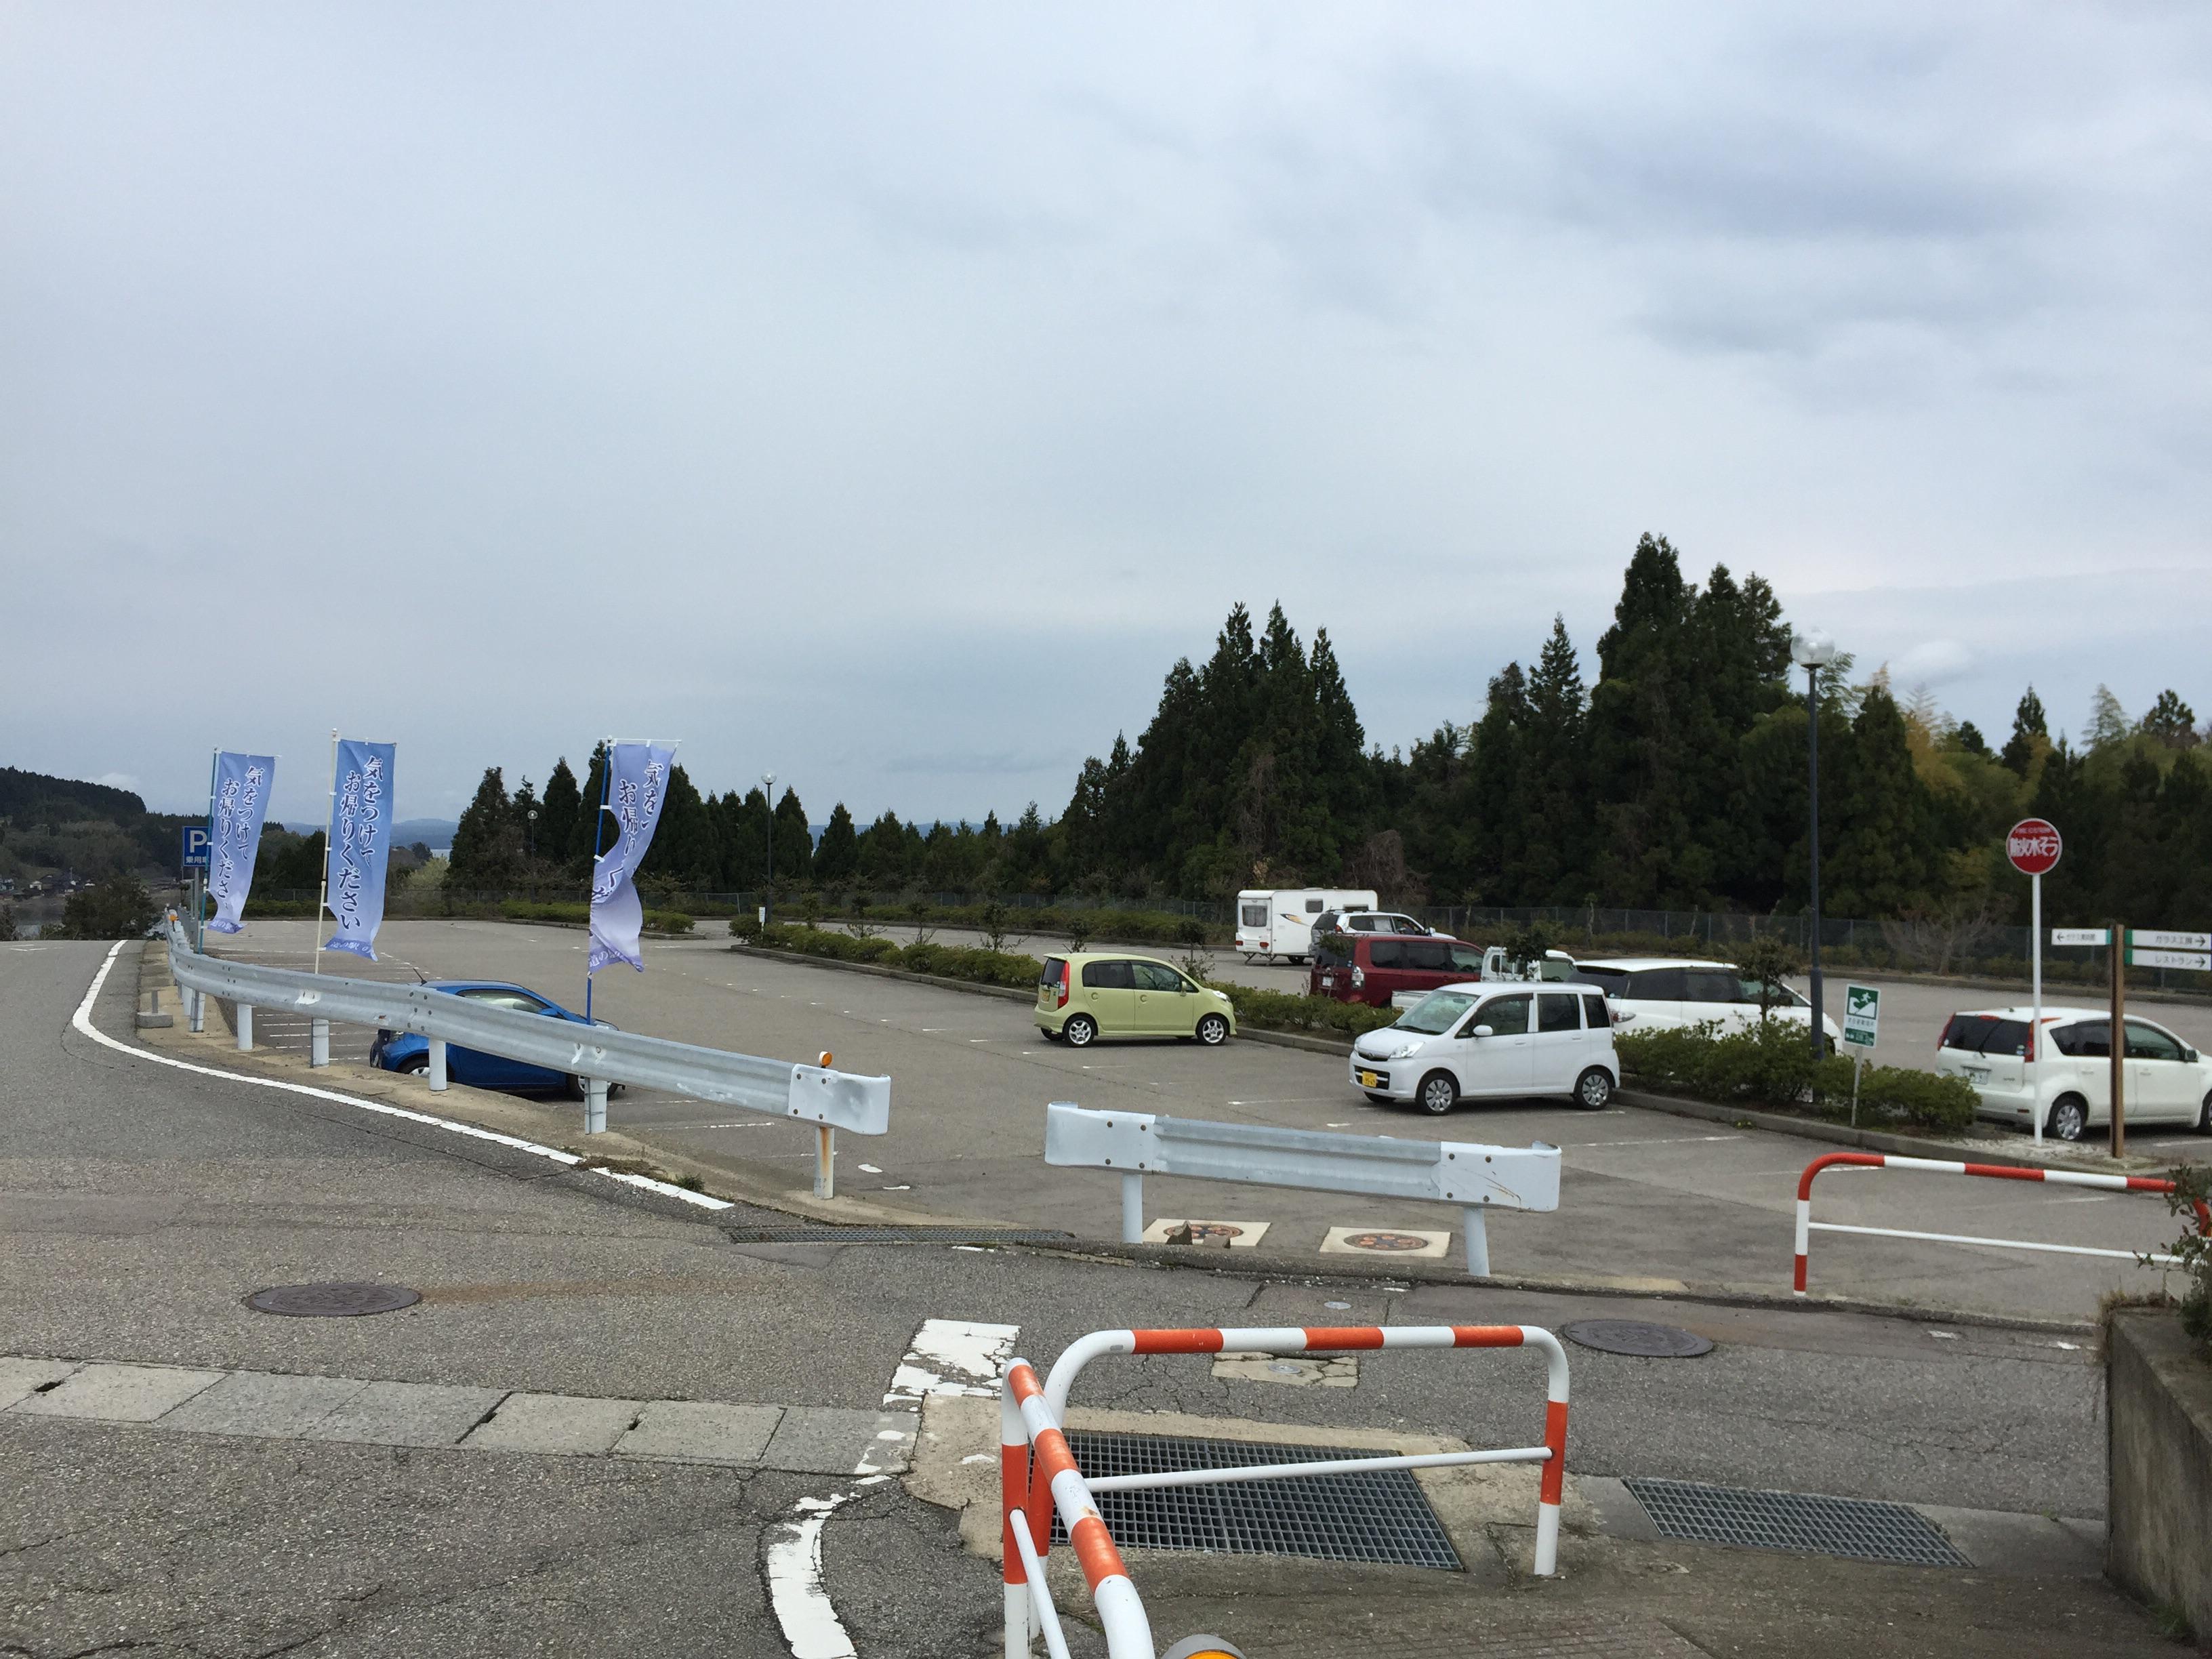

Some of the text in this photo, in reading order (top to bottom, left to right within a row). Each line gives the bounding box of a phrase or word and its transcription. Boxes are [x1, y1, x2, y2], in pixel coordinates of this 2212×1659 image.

[190, 830, 207, 853] P
[236, 766, 264, 860] 気をつけて
[338, 771, 361, 929] お帰りください
[359, 755, 383, 867] 気をつけて
[2156, 956, 2192, 965] レストラン
